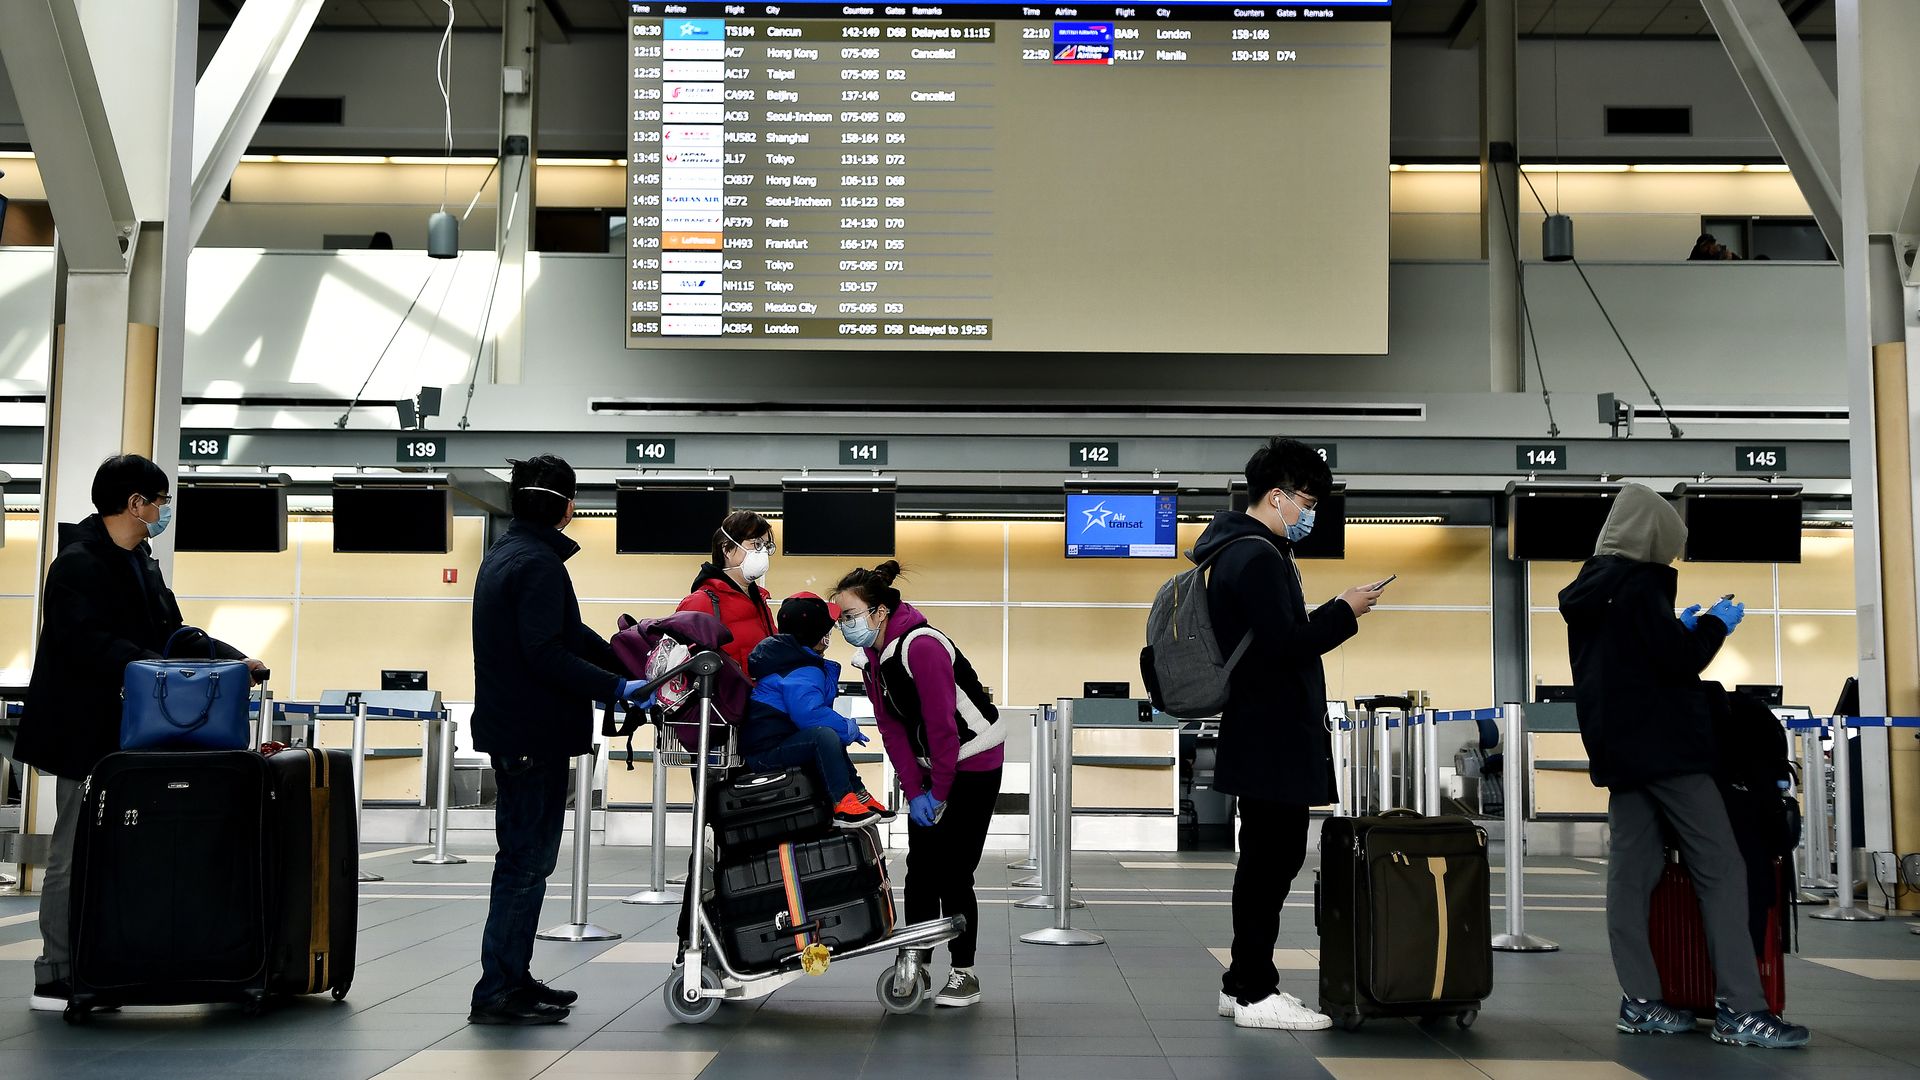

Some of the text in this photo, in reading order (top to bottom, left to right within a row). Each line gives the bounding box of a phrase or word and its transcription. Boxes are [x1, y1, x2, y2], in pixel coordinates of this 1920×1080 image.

[632, 4, 943, 15] Time Airline Flight City Counters Gates Remarks
[1023, 7, 1334, 18] Time Airline Flight City Counters Gates Remarks
[634, 25, 662, 36] 08:30
[726, 26, 755, 37] TS184
[767, 26, 802, 37] Cancun
[843, 27, 880, 38] 142-149
[912, 27, 949, 40] Delayed
[951, 27, 962, 38] to
[964, 27, 991, 38] 11:15
[1023, 28, 1270, 40] 22:10 BA84 London 158-166
[635, 46, 956, 61] 12:15 AC7 Hong Kong 075-095 Cancelled
[1023, 49, 1297, 61] 22:50 PR117 Manila 150-156 D74
[634, 67, 906, 81] 12:25 AC17 Taipei 075-095 D52
[634, 88, 661, 100] 12:50
[725, 89, 755, 101] CA992
[767, 90, 799, 103] Beijing
[842, 90, 880, 101] 137-146
[911, 90, 956, 102] Cancelled
[634, 110, 661, 121] 13:00
[767, 111, 833, 122] Seoul-Incheon
[841, 111, 879, 123] 075-095
[886, 112, 906, 123] D69
[634, 131, 906, 145] 13:20 MU582 Shanghai 158-164 D54
[634, 152, 906, 166] 13:45 JL17 Tokyo 131-136 D72
[634, 173, 660, 185] 14:05
[724, 174, 754, 185] CX837
[767, 175, 791, 188] Hong
[793, 175, 817, 188] Kong
[841, 175, 879, 186] 106-113
[634, 195, 905, 207] 14:05 KE72 Seoul-Incheon 116-123 D58
[633, 216, 905, 229] 14:20 AF379 Paris 124-130 D70
[633, 237, 905, 250] 14:20 LH493 Frankfurt 166-174 D55
[633, 258, 904, 272] 14:50 AC3 Tokyo 075-095 D71
[633, 279, 878, 294] 16:15 NH115 Tokyo 150-157
[633, 301, 904, 315] 16:55 AC996 Mexico City 075-095 D53
[632, 322, 988, 337] 18:55 AC854 London 075-095 D58 Delayed to 19:55
[189, 440, 219, 454] 138
[407, 443, 436, 457] 139
[636, 444, 665, 458] 140
[850, 445, 877, 459] 141
[1079, 447, 1109, 461] 142
[1527, 450, 1557, 465] 144
[1746, 451, 1777, 466] 145
[1112, 513, 1126, 521] Air
[1109, 520, 1144, 529] transat
